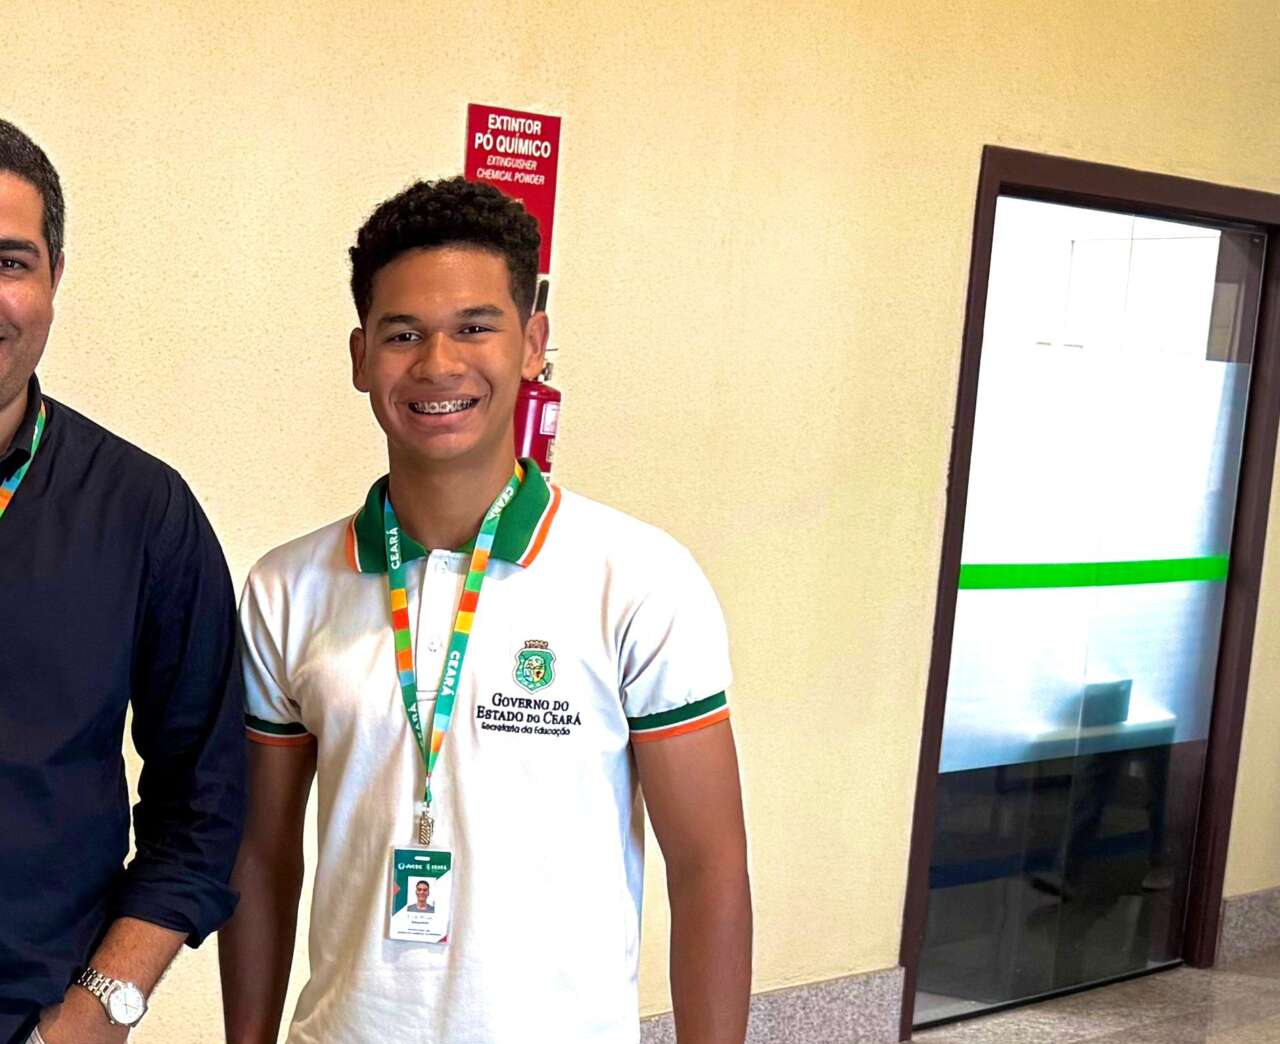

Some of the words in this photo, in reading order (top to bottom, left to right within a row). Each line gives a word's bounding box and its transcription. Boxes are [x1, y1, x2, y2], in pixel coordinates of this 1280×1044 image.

[488, 114, 541, 135] EXTINTOR
[474, 129, 494, 151] PÓ
[496, 133, 551, 158] QUÍMICO
[486, 155, 537, 171] EXTINGUISHER
[476, 167, 513, 182] CHEMICAL
[514, 172, 545, 185] POWDER
[386, 526, 401, 570] CEARÁ
[441, 650, 460, 697] CEARÁ
[492, 692, 550, 711] GOVERNO
[552, 700, 569, 712] DO
[477, 705, 524, 722] ESTADO
[526, 714, 540, 724] DO
[543, 711, 582, 726] CEARÁ
